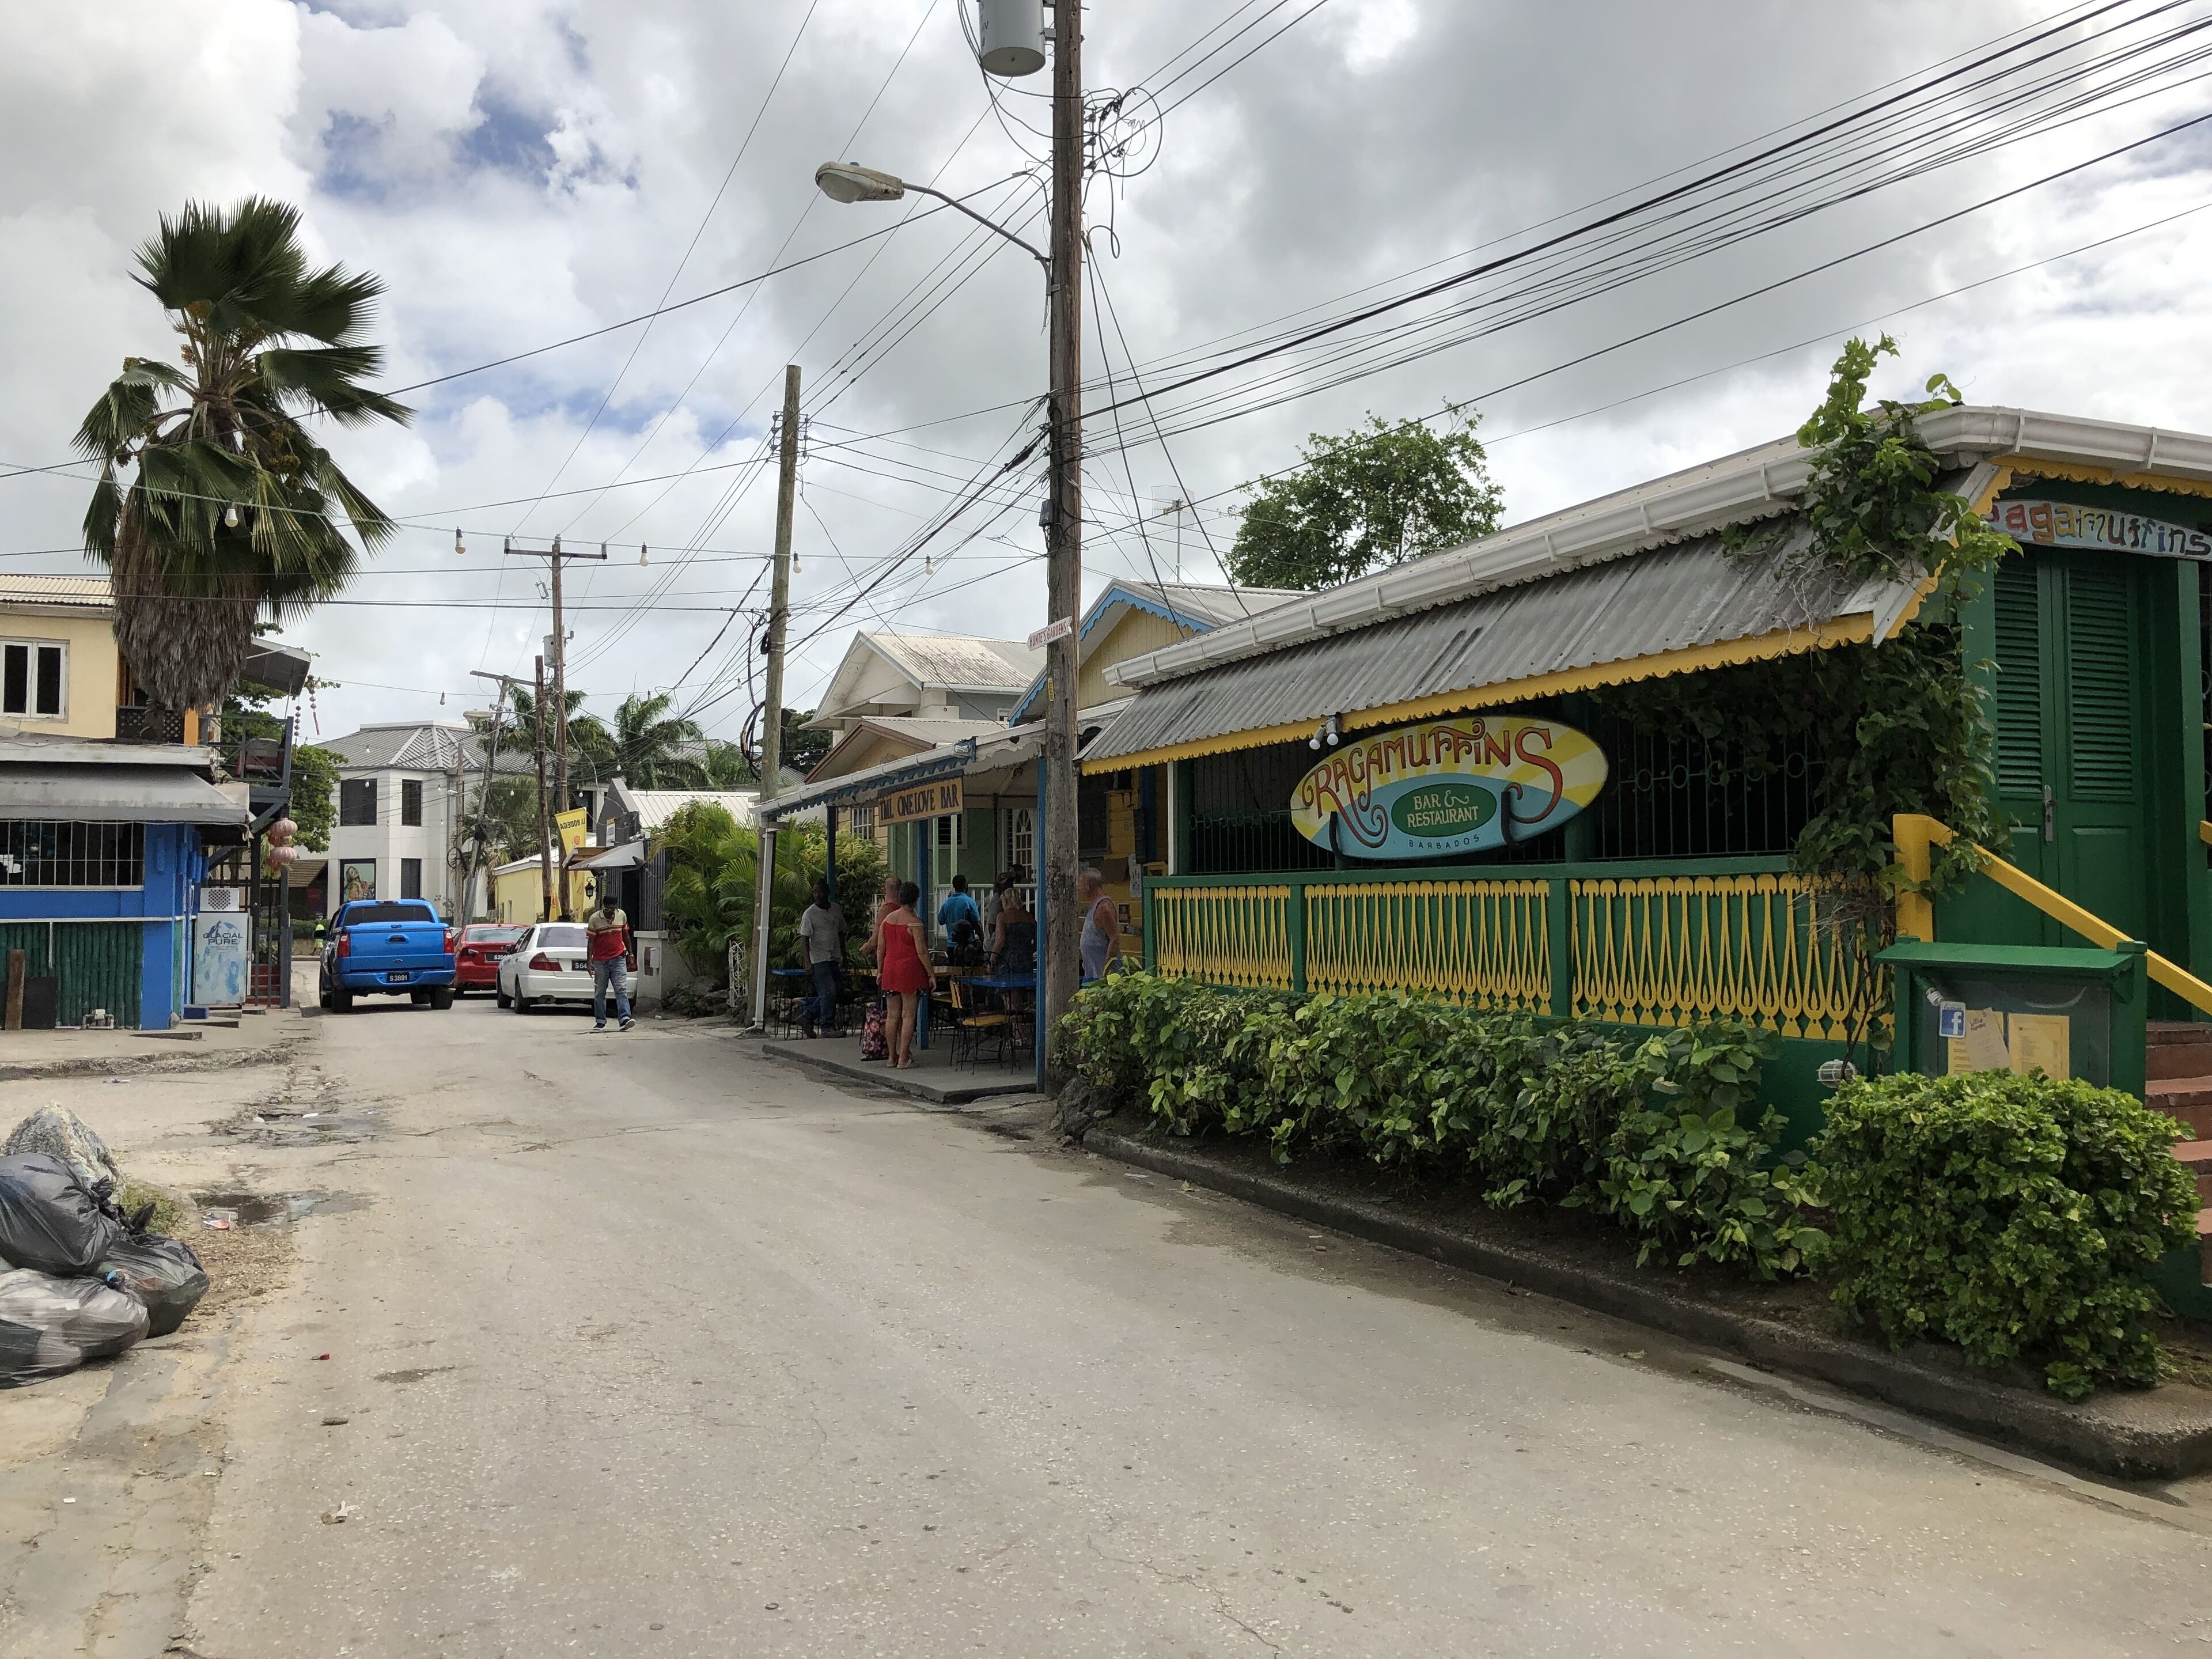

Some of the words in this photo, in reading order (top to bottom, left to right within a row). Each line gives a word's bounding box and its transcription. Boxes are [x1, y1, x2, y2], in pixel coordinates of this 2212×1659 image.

[1029, 630, 1046, 647] HUNTE'S
[1047, 621, 1066, 639] GARDENS
[940, 783, 960, 809] BAR
[1413, 793, 1441, 810] BAR
[1406, 805, 1479, 828] RESTAURANT
[1408, 834, 1481, 850] BARBADOS
